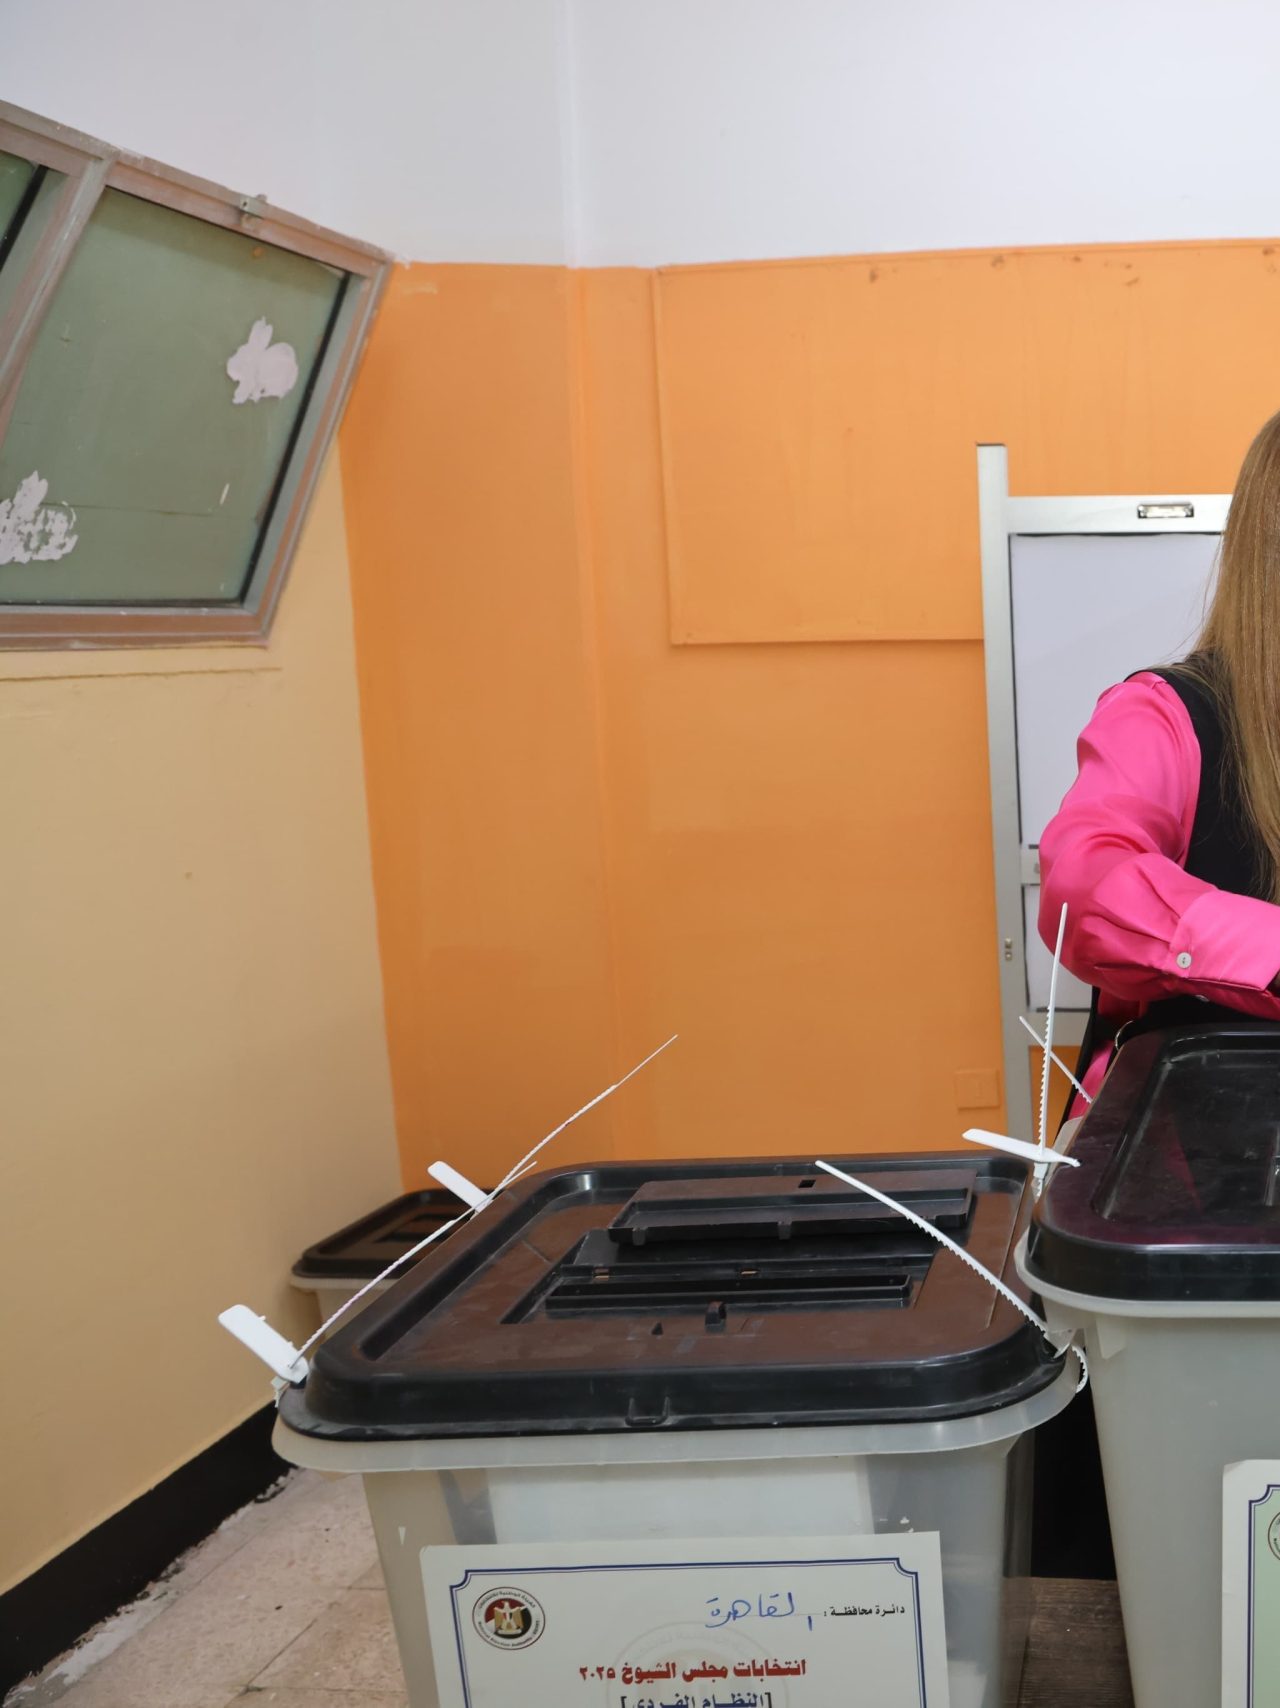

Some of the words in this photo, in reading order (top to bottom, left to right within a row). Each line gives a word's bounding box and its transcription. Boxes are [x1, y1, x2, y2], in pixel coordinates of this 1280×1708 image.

[875, 1605, 906, 1617] دائرة
[579, 1666, 616, 1682] ٢٠٢٥
[621, 1662, 676, 1685] الشيوخ
[681, 1659, 729, 1683] مجلس
[733, 1658, 807, 1682] انتخابات
